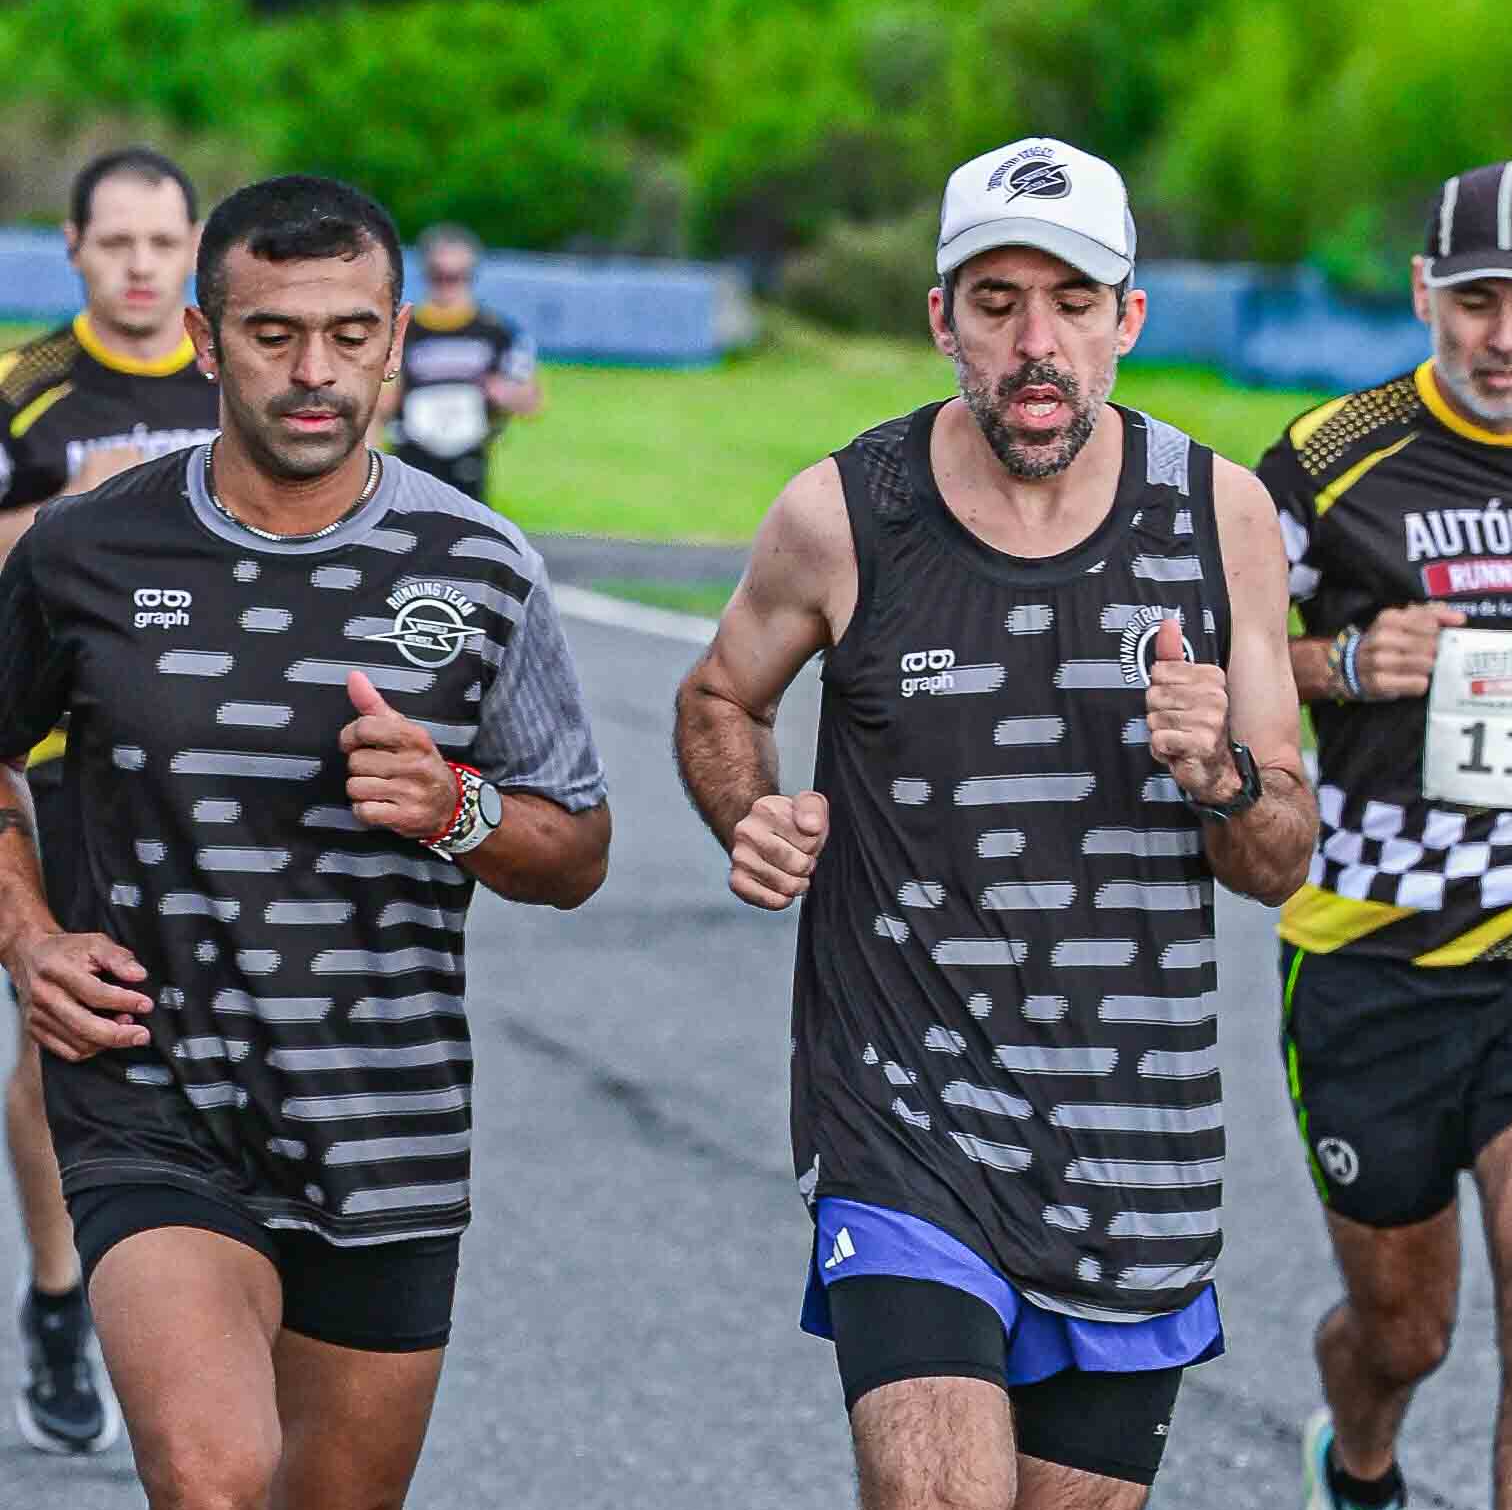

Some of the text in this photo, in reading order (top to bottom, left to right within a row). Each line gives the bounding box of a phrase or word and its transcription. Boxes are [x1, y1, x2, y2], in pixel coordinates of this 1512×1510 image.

[443, 585, 477, 617] TEAM
[134, 608, 190, 629] graph
[901, 671, 954, 698] graph
